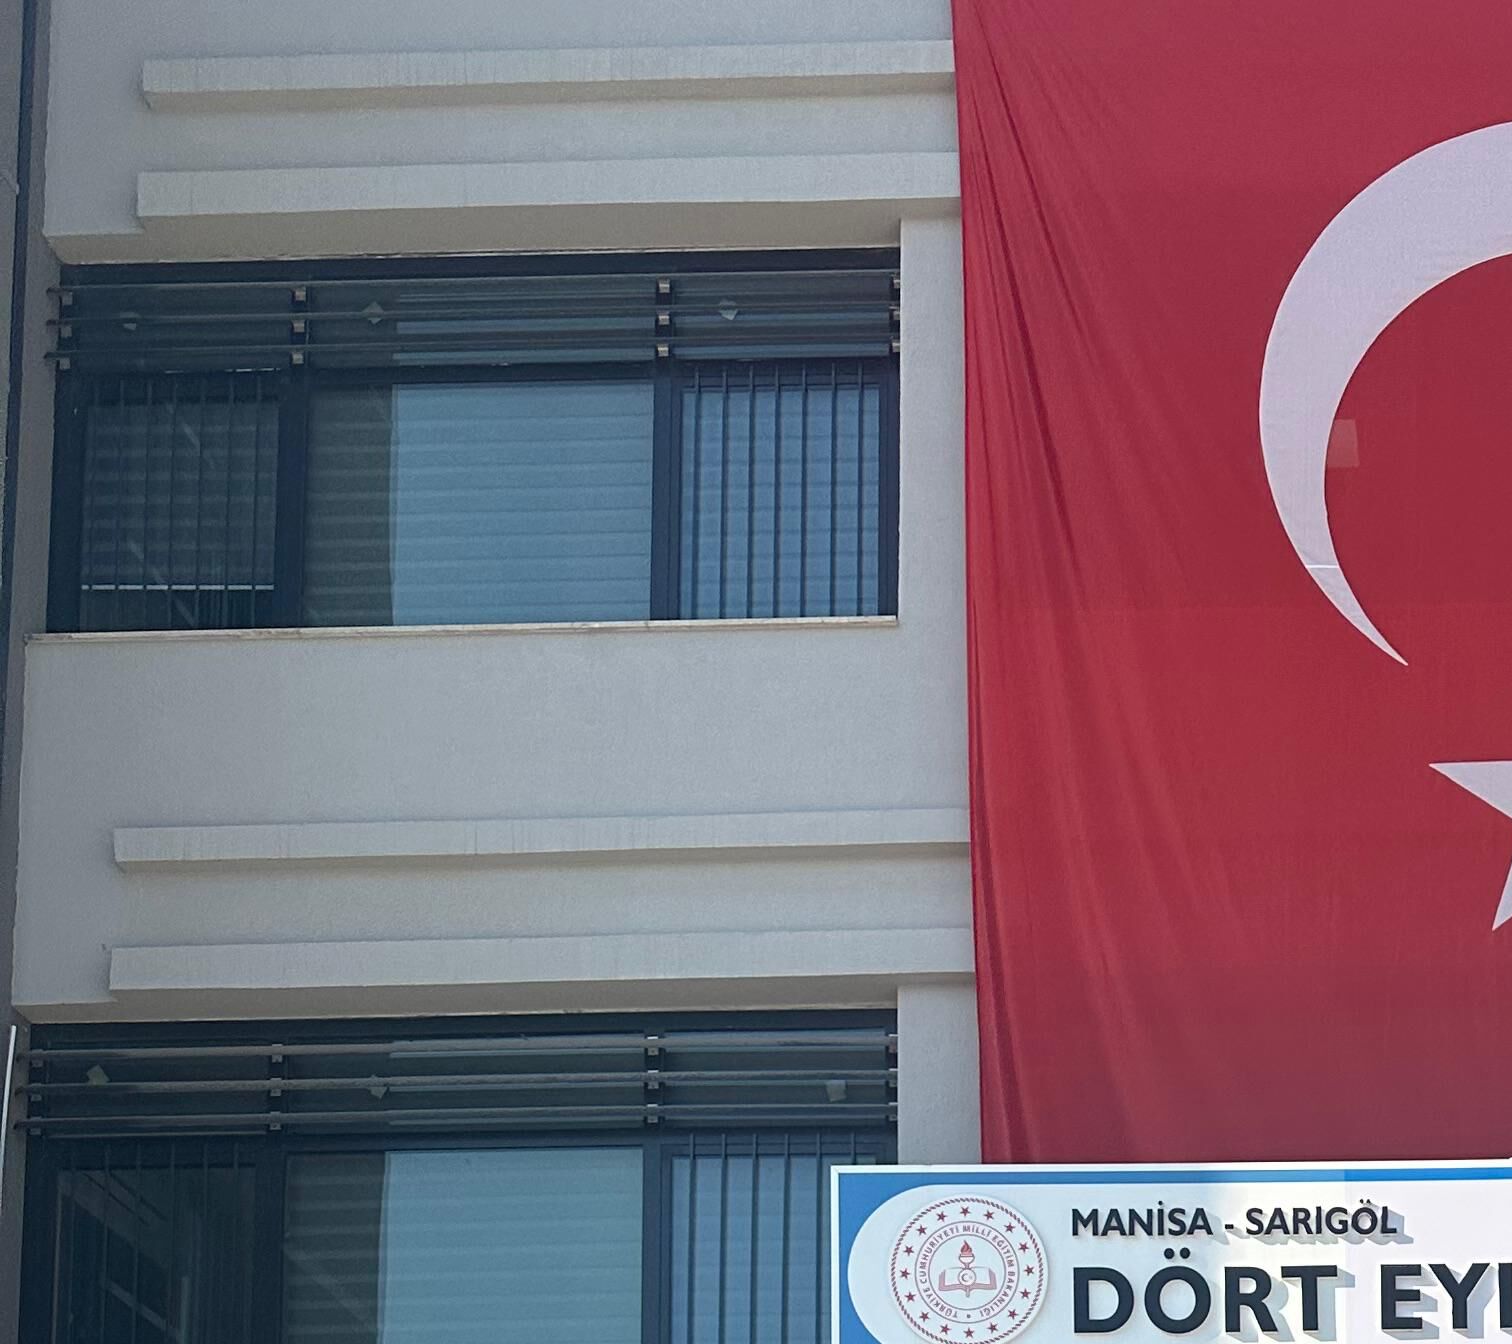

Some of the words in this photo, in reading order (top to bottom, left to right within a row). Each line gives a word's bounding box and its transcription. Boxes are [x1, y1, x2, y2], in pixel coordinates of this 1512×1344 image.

[1072, 1200, 1213, 1236] MANİSA
[1246, 1199, 1397, 1236] SARIGÖL
[1072, 1247, 1339, 1334] DÖRT
